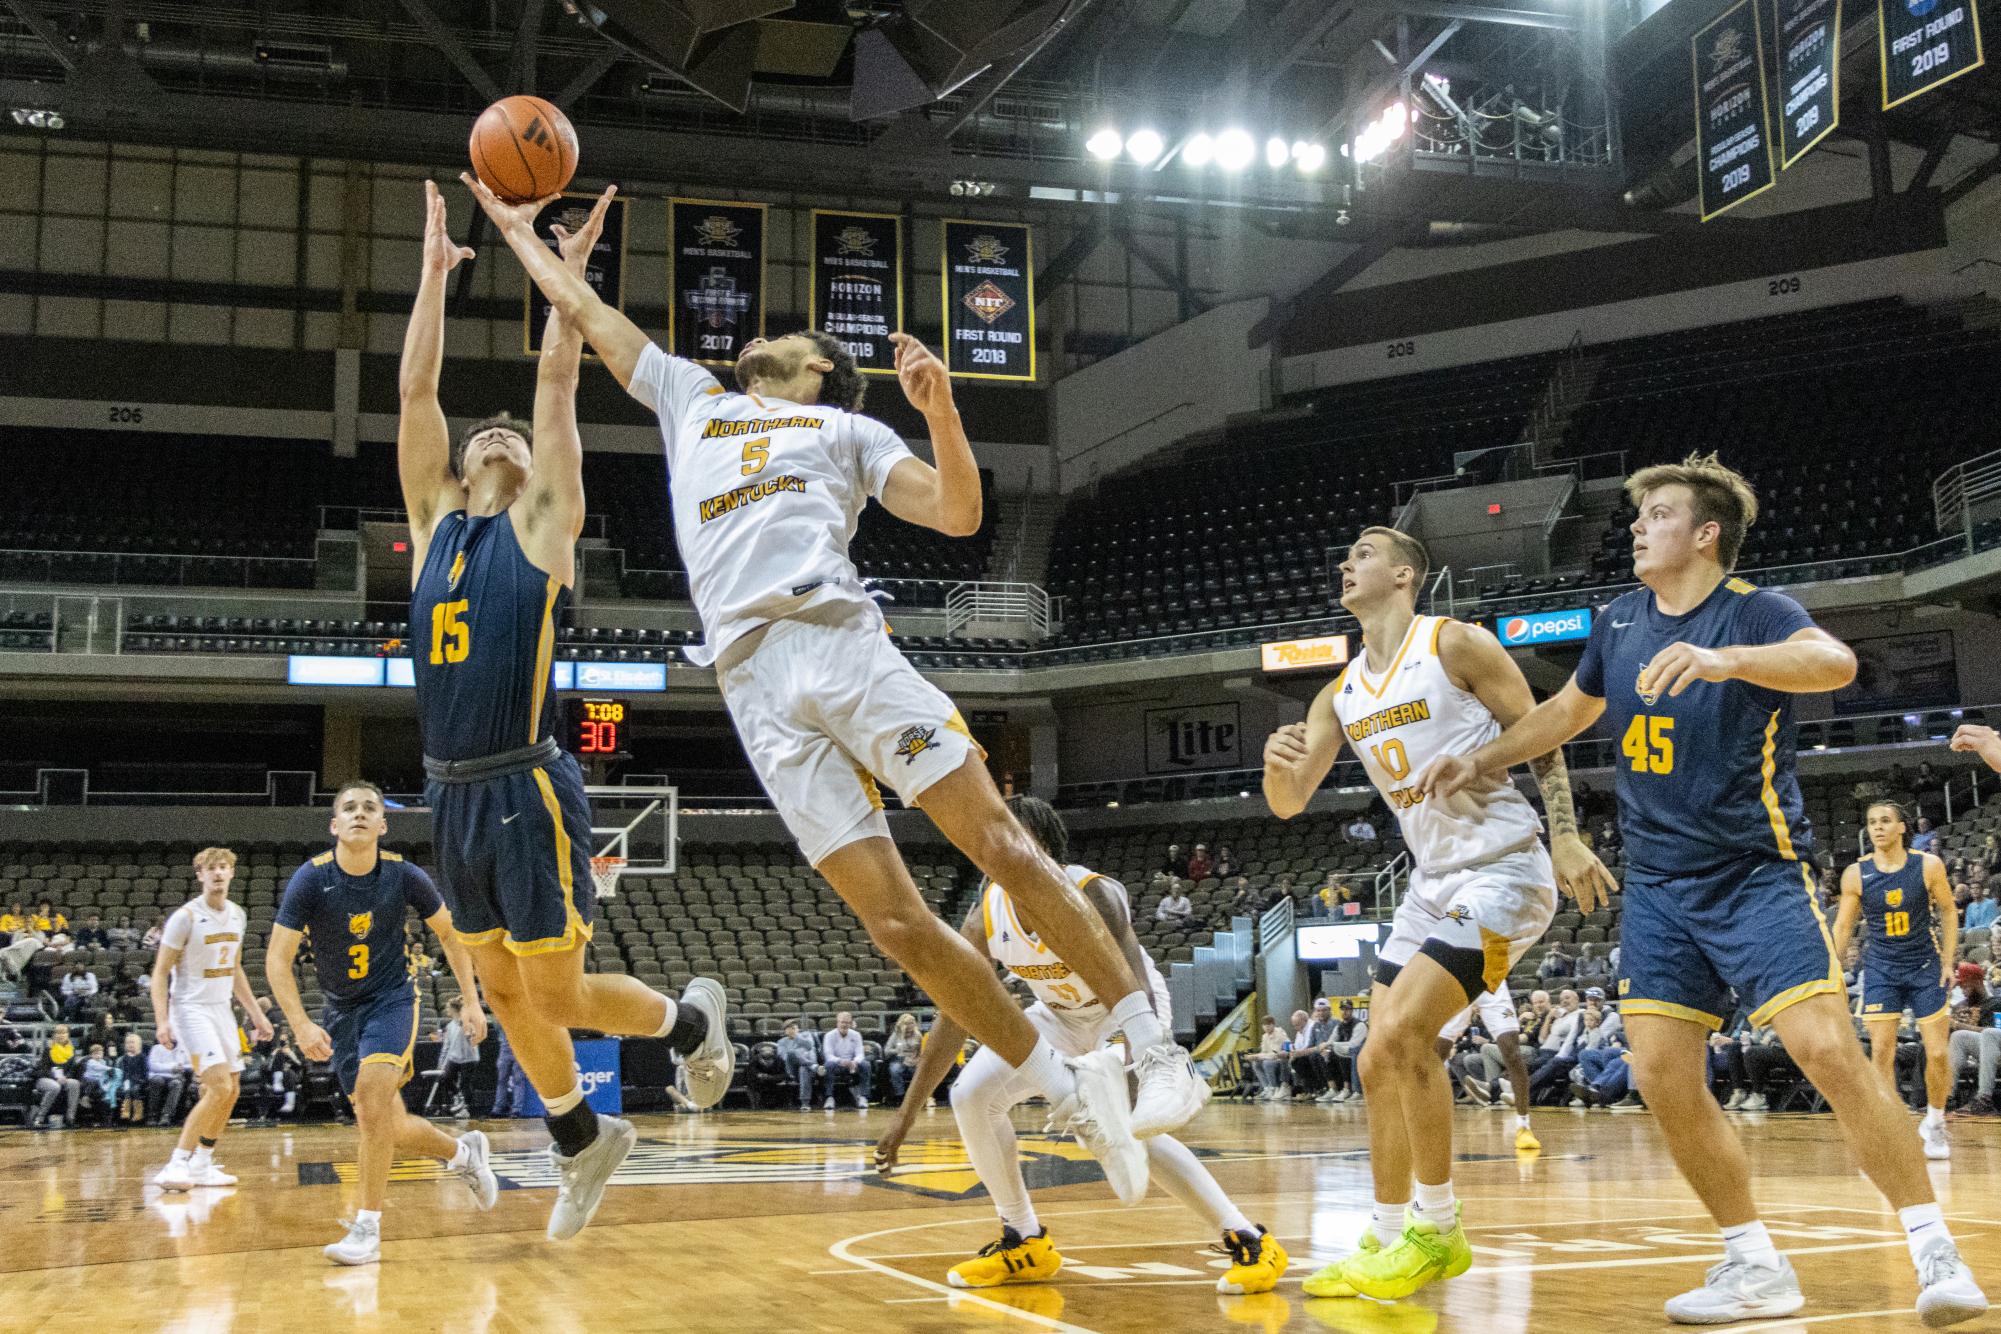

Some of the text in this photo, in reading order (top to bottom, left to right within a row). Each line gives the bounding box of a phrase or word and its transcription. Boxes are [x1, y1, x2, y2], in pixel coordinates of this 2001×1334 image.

[1892, 7, 1964, 56] FIRST ROUND
[1911, 42, 1950, 77] 2019
[1796, 105, 1819, 138] 2019
[1709, 134, 1760, 172] CHAMPIONS
[1722, 163, 1751, 193] 2019
[707, 249, 752, 259] BASKETBALL
[844, 258, 889, 269] BASKETBALL
[954, 265, 1020, 277] MEN'S BASKETBALL
[830, 281, 882, 295] HORIZON
[1769, 277, 1800, 296] 209
[974, 296, 1004, 308] NIT
[824, 321, 889, 336] CHAMPIONS
[955, 328, 1023, 344] FIRST ROUND
[700, 334, 734, 350] 2017
[1387, 341, 1415, 359] 208
[972, 348, 1007, 365] 2018
[110, 406, 143, 424] 206
[701, 415, 825, 440] NORTHERN
[740, 436, 771, 477] 5
[698, 474, 808, 525] KENTUCKY
[429, 598, 470, 665] 15
[1531, 614, 1584, 639] pepsi
[584, 703, 624, 722] 7:08
[1344, 698, 1431, 742] NORTHERN
[580, 721, 616, 752] 30
[1166, 720, 1235, 766] Lite
[1621, 714, 1675, 775] 45
[1370, 737, 1412, 781] 10
[1884, 911, 1910, 936] 10
[218, 945, 230, 965] 2
[348, 943, 370, 979] 3
